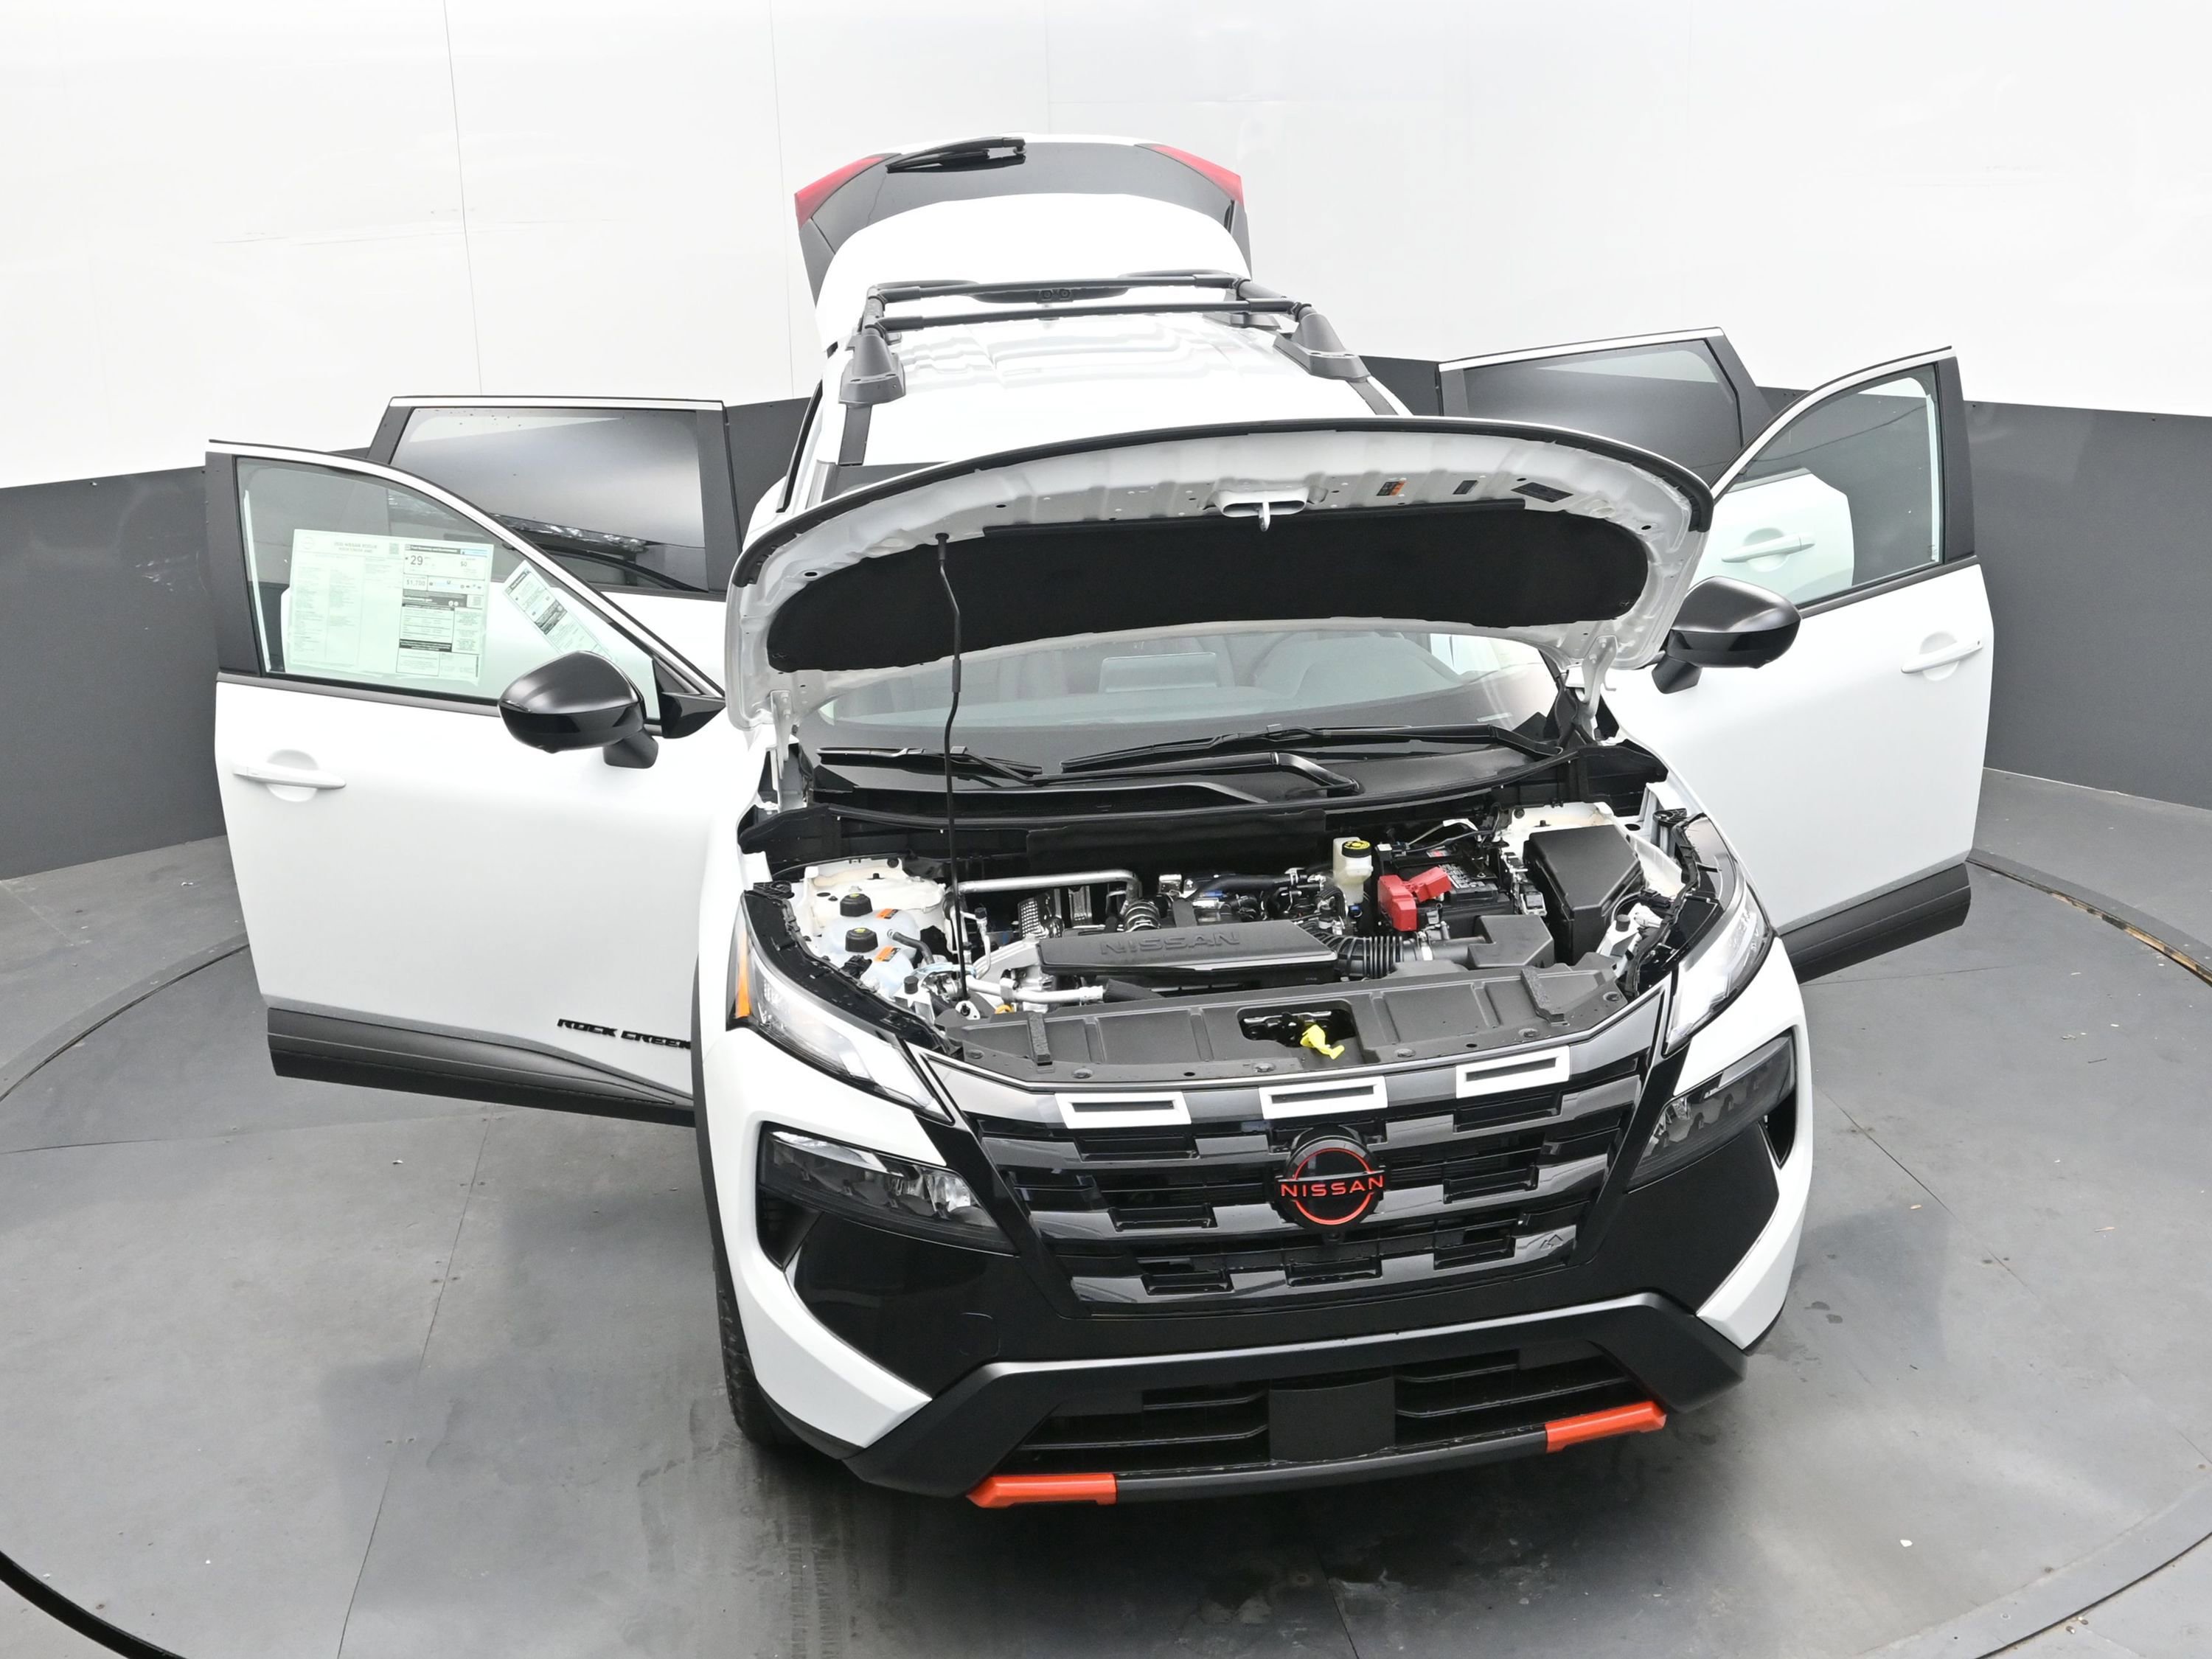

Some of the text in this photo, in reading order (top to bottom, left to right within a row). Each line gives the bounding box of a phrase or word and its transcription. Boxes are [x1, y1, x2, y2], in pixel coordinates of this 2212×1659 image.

[410, 554, 424, 566] 29
[1099, 931, 1240, 955] NISSAN
[557, 1018, 692, 1049] ROCK CREEK
[1280, 1175, 1384, 1197] NISSAN
